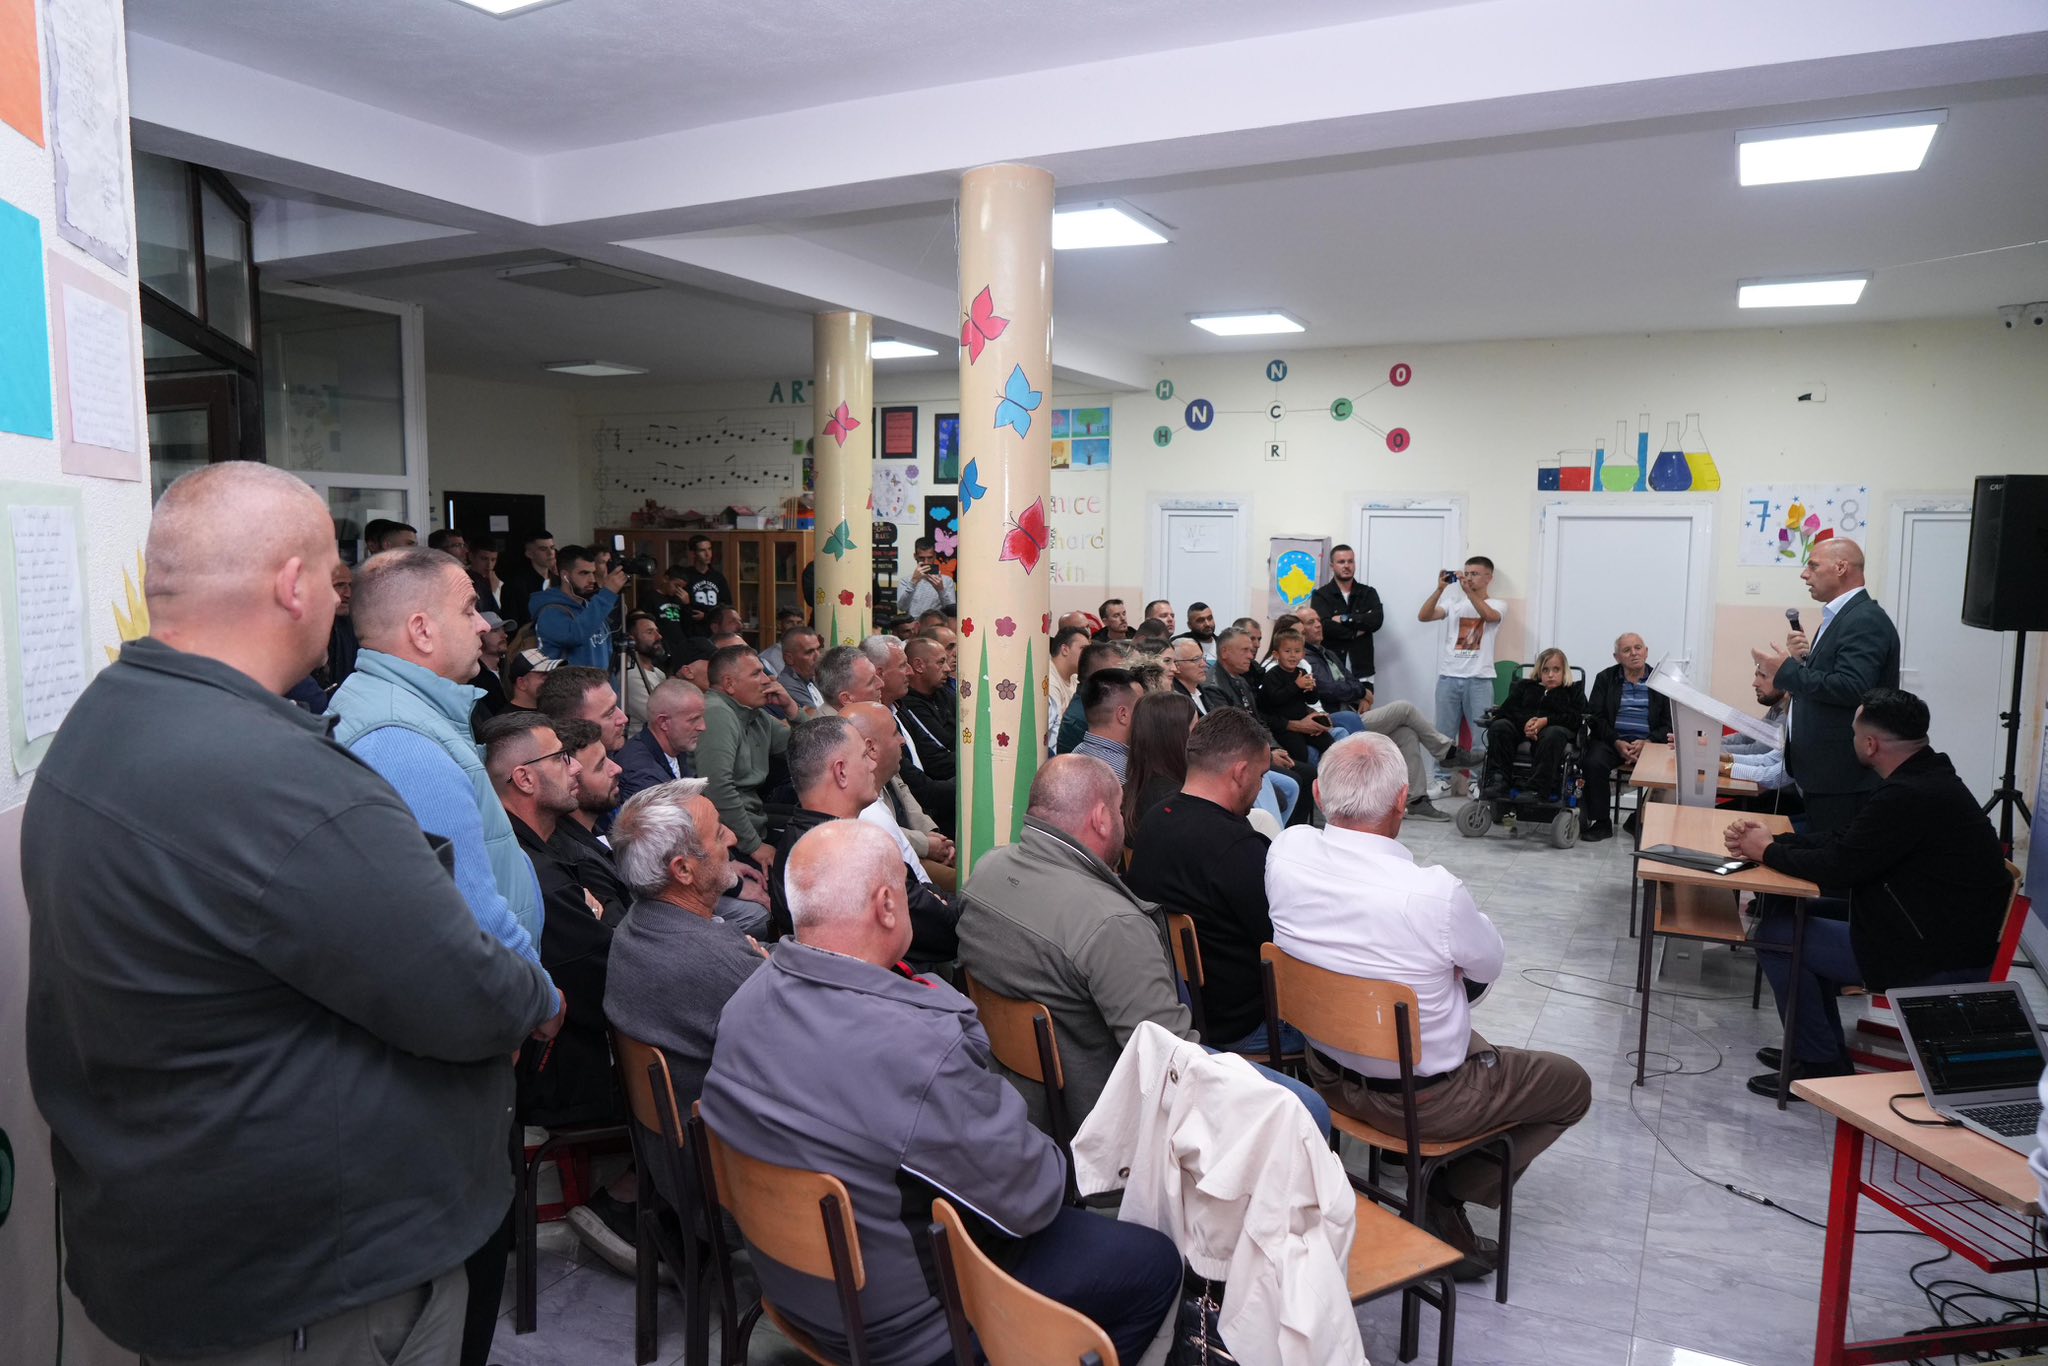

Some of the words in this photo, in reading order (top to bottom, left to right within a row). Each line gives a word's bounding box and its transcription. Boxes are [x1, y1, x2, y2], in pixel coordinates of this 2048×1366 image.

[769, 380, 815, 404] AR
[1191, 405, 1207, 423] N
[1749, 500, 1771, 532] 7
[1840, 499, 1859, 532] 8
